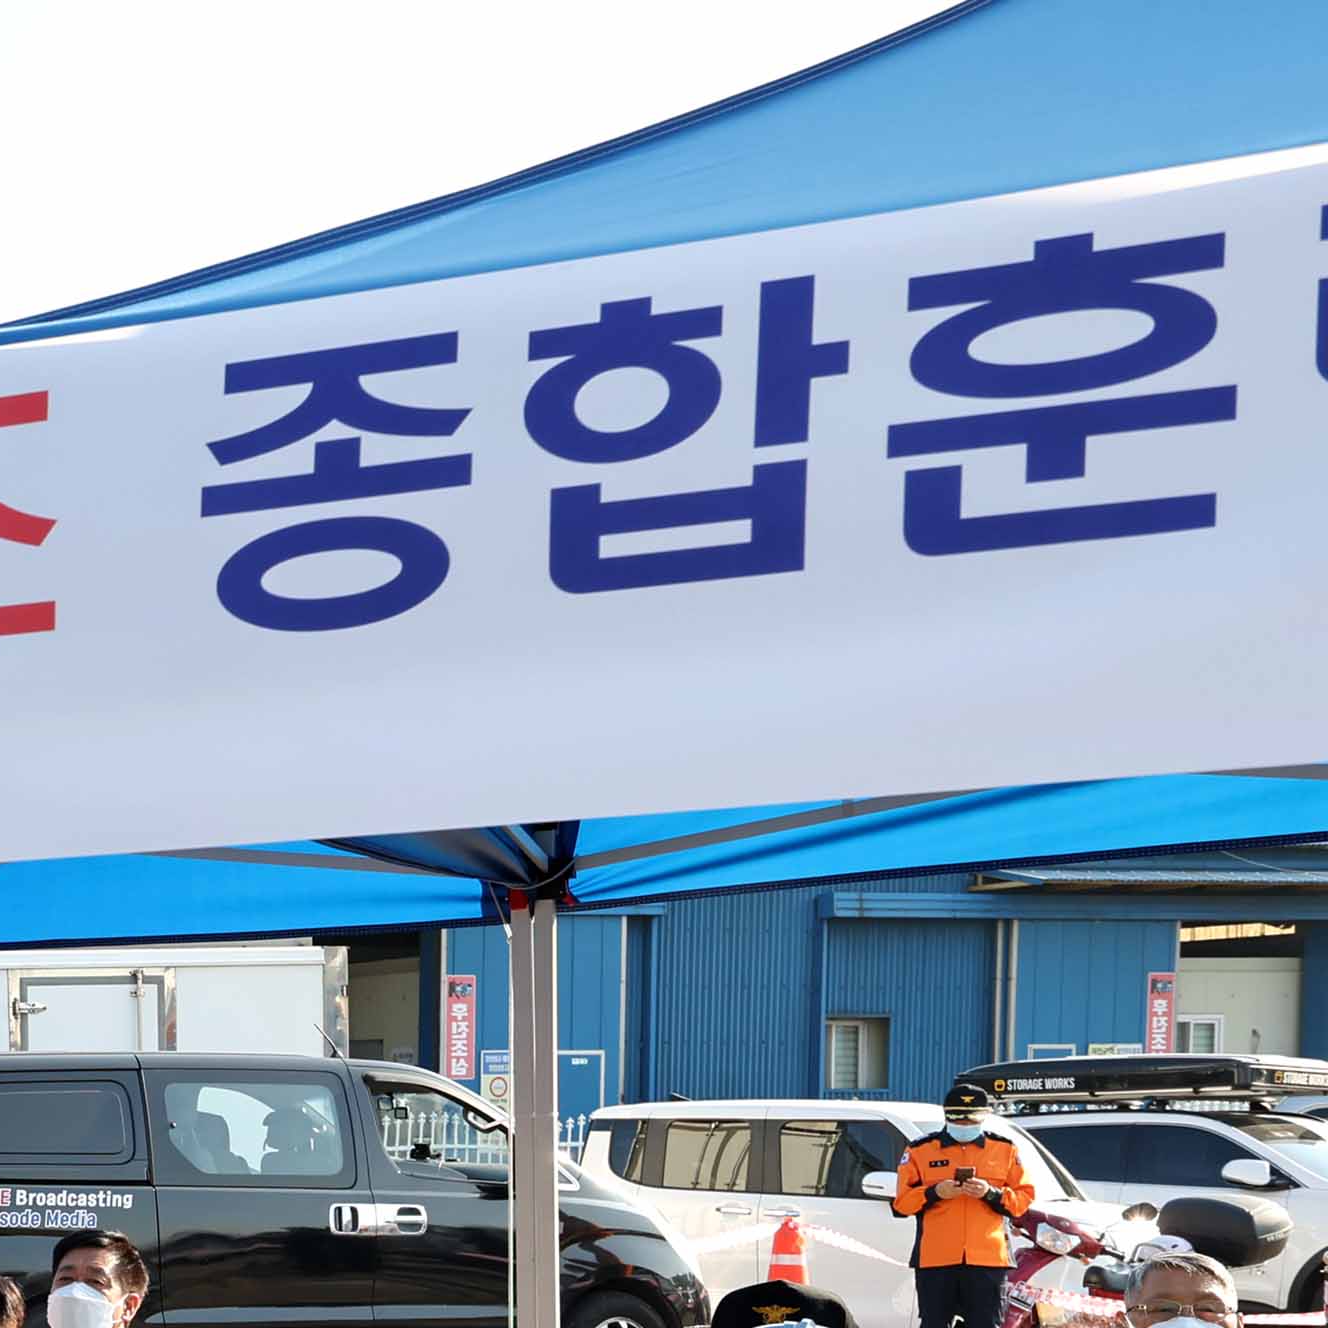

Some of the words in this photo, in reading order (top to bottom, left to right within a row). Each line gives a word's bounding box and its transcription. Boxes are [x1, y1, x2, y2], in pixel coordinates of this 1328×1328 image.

[201, 208, 1328, 633] 종합훈
[1006, 1079, 1043, 1091] STORAGE
[1045, 1078, 1075, 1090] WORKS
[15, 1190, 133, 1208] Broadcasting
[44, 1209, 98, 1228] Media
